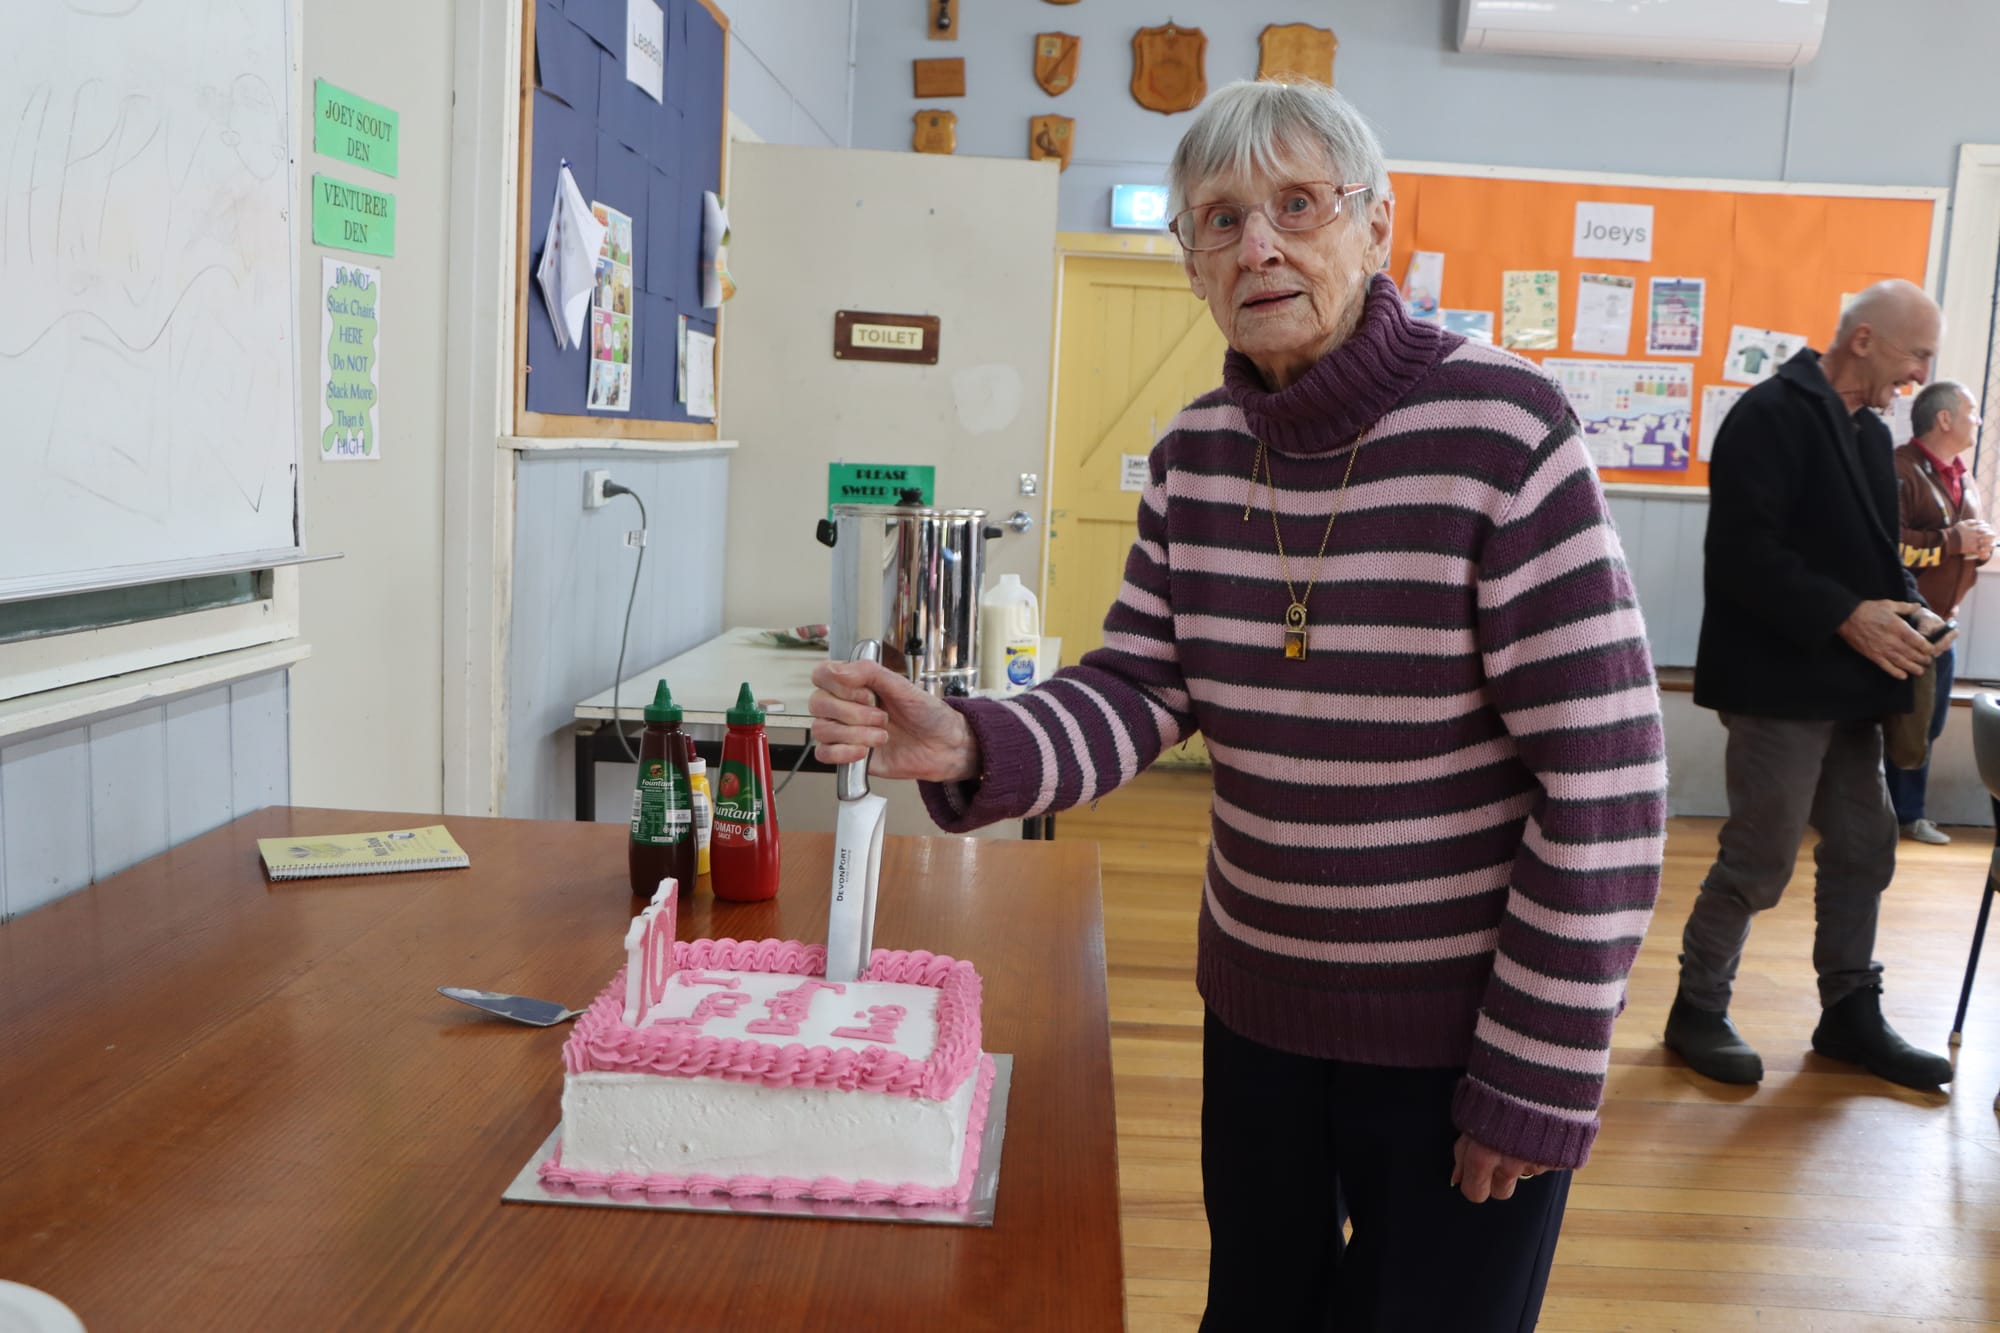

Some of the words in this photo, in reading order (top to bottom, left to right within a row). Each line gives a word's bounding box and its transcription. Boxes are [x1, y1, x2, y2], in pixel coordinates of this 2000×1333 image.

[325, 99, 354, 129] JOEY
[356, 111, 392, 142] SCOUT
[347, 137, 370, 162] DEN
[323, 182, 388, 218] VENTURER
[344, 219, 368, 244] DEN
[1583, 219, 1647, 246] Joeys
[335, 267, 347, 286] Do
[348, 269, 370, 291] NOT
[327, 295, 349, 315] Stack
[350, 299, 376, 319] Chairs
[338, 325, 363, 345] HERE
[858, 328, 918, 345] TOILET
[333, 353, 345, 370] Do
[346, 354, 368, 373] NOT
[327, 382, 349, 399] Stack
[350, 383, 373, 401] More
[337, 410, 357, 428] Than
[336, 437, 366, 456] HIGH
[856, 468, 907, 480] PLEASE
[841, 485, 888, 496] SWEEP
[641, 778, 674, 788] Fountain
